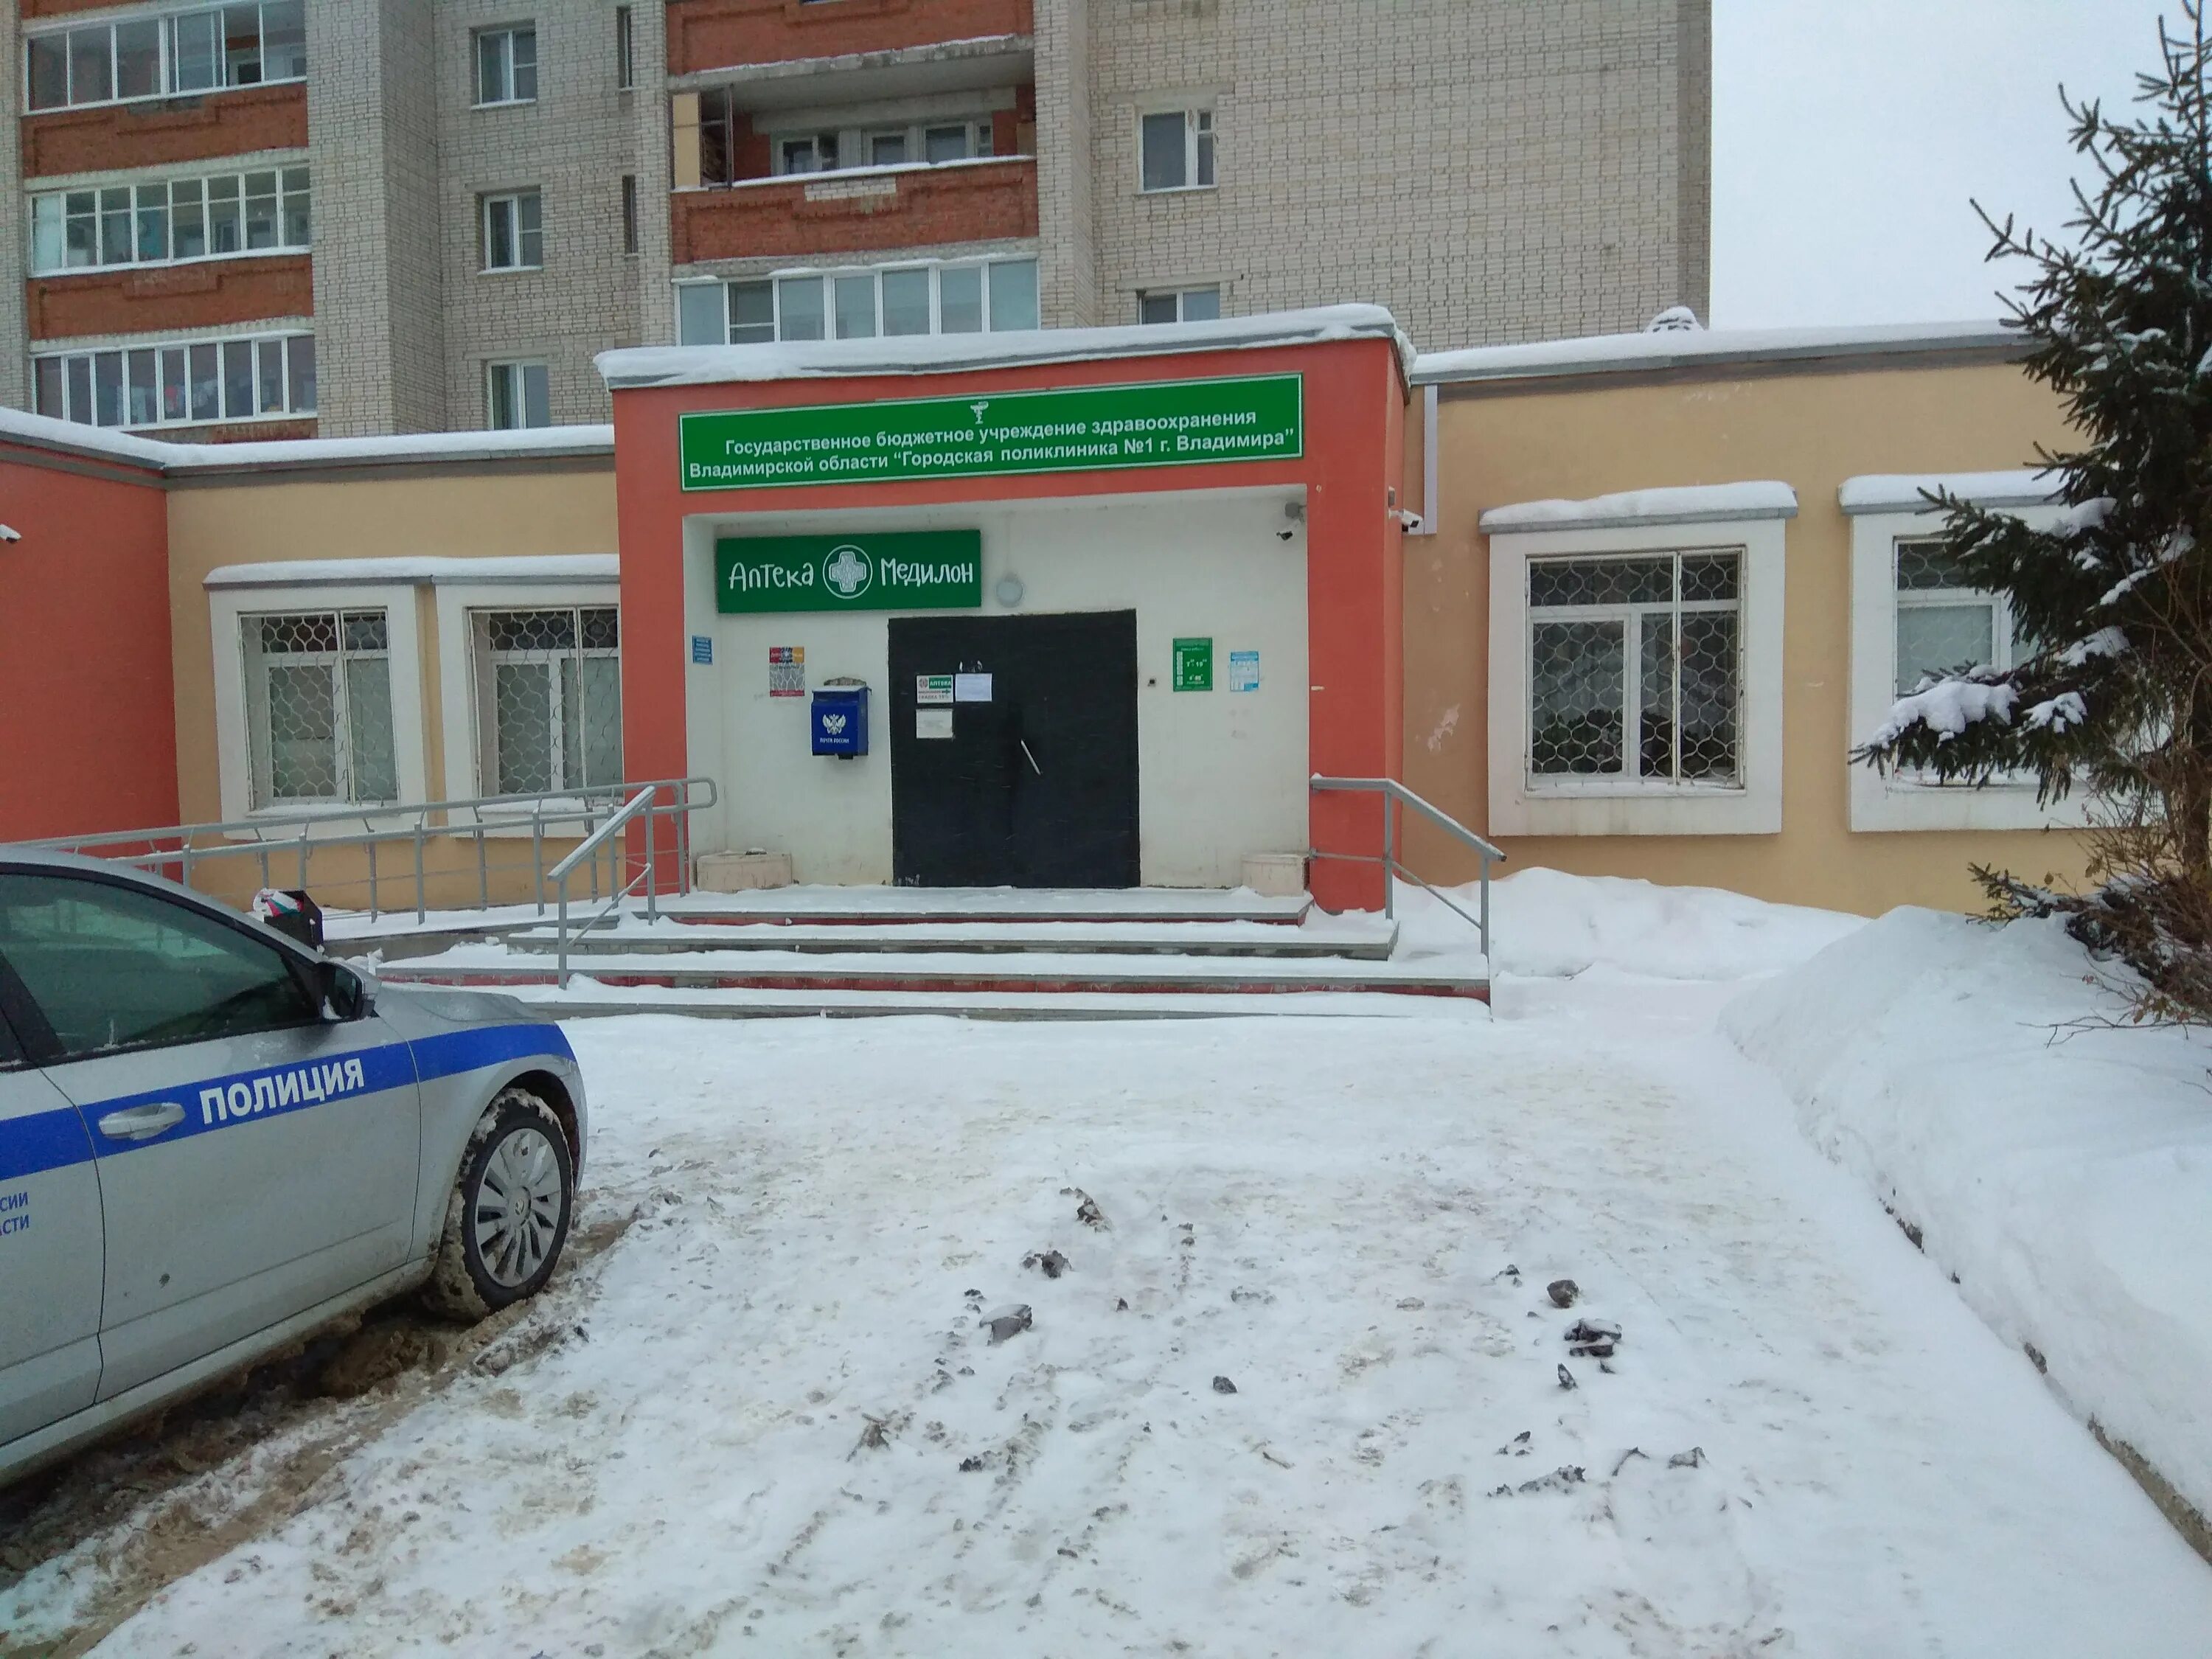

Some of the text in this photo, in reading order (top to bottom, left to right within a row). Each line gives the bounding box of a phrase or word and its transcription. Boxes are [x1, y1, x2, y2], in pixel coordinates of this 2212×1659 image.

[725, 411, 1256, 457] Государственное бюджетное учреждение здравоохранения
[689, 457, 813, 479] Владимирской
[819, 451, 888, 472] области
[1001, 439, 1118, 462] поликлиника
[1124, 437, 1153, 454] №1
[1160, 440, 1171, 453] г.
[729, 557, 973, 592] Аптека Медилон
[199, 1057, 365, 1124] ПОЛИЦИЯ
